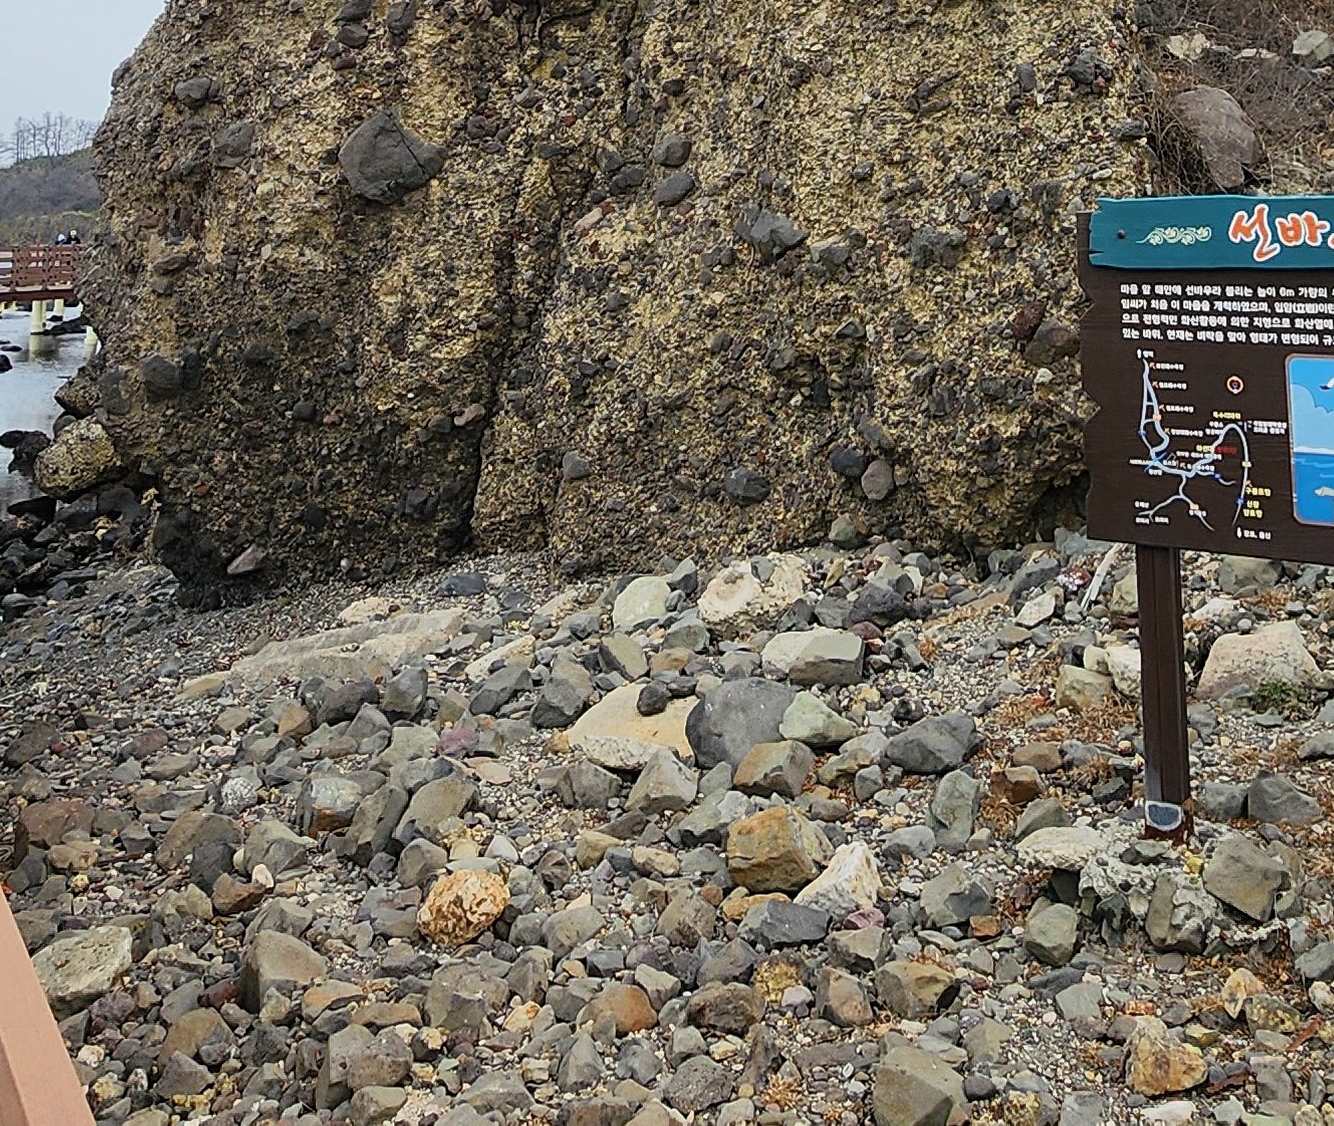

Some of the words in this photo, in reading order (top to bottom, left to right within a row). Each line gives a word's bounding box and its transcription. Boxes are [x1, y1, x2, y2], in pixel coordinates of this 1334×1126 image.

[1120, 284, 1138, 295] 마을
[1141, 284, 1151, 295] 앞
[1185, 284, 1222, 296] 선바우라
[1225, 285, 1254, 297] 불리는
[1257, 286, 1276, 297] 높이
[1279, 287, 1295, 297] 6m
[1298, 286, 1328, 298] 가량의
[1120, 298, 1148, 310] 임씨가
[1150, 299, 1168, 310] 처음
[1170, 299, 1180, 311] 이
[1183, 299, 1211, 312] 마을을
[1213, 300, 1272, 313] 개척하였으며,
[1121, 313, 1141, 324] 으로
[1143, 314, 1178, 326] 전형적인
[1181, 314, 1227, 327] 화산활동에
[1230, 316, 1250, 328] 의한
[1253, 317, 1292, 329] 지형으로
[1122, 327, 1140, 339] 있는
[1142, 328, 1164, 340] 바위.
[1166, 329, 1194, 341] 현재는
[1196, 330, 1224, 342] 벼락을
[1227, 331, 1247, 343] 맞아
[1249, 332, 1278, 344] 형태가
[1281, 333, 1319, 345] 변형되어
